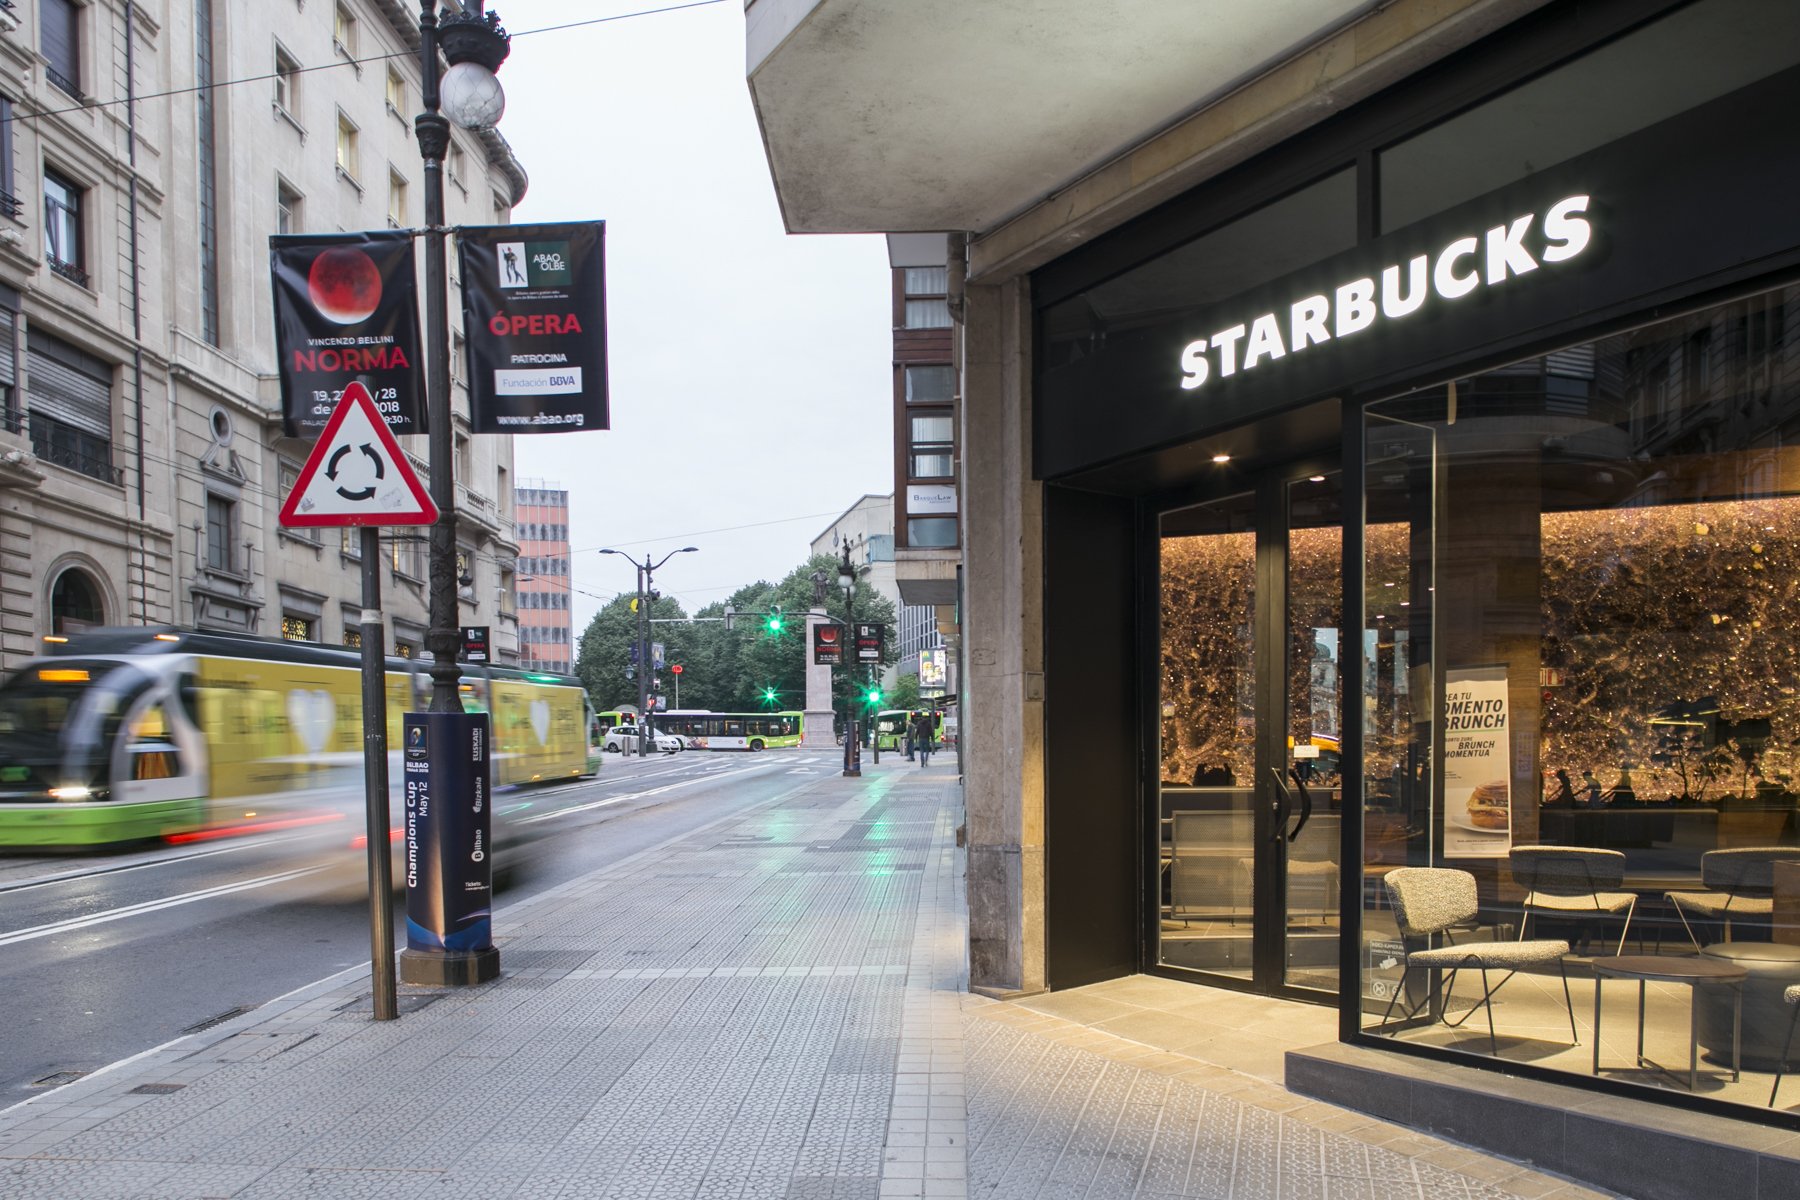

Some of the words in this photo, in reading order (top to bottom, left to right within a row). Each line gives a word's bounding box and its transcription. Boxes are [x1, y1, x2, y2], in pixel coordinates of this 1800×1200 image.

[533, 253, 561, 263] ABAO
[540, 261, 565, 271] OLBE
[1181, 195, 1592, 390] STARBUCKS
[488, 311, 582, 336] ÓPERA
[308, 337, 356, 347] VINCENZO
[357, 335, 394, 345] BELLINI
[294, 346, 410, 373] NORMA
[510, 353, 568, 364] PATROCINA
[503, 378, 547, 388] Fundación
[549, 375, 575, 386] BBVA
[312, 390, 331, 403] 19,
[381, 387, 397, 399] 28
[312, 403, 331, 415] de
[496, 411, 584, 426] www.abao.org
[1461, 691, 1471, 700] TU
[1458, 740, 1495, 750] BRUNCH
[419, 781, 428, 792] 12
[407, 781, 418, 808] Cup
[419, 795, 430, 817] May
[408, 811, 418, 888] Champions
